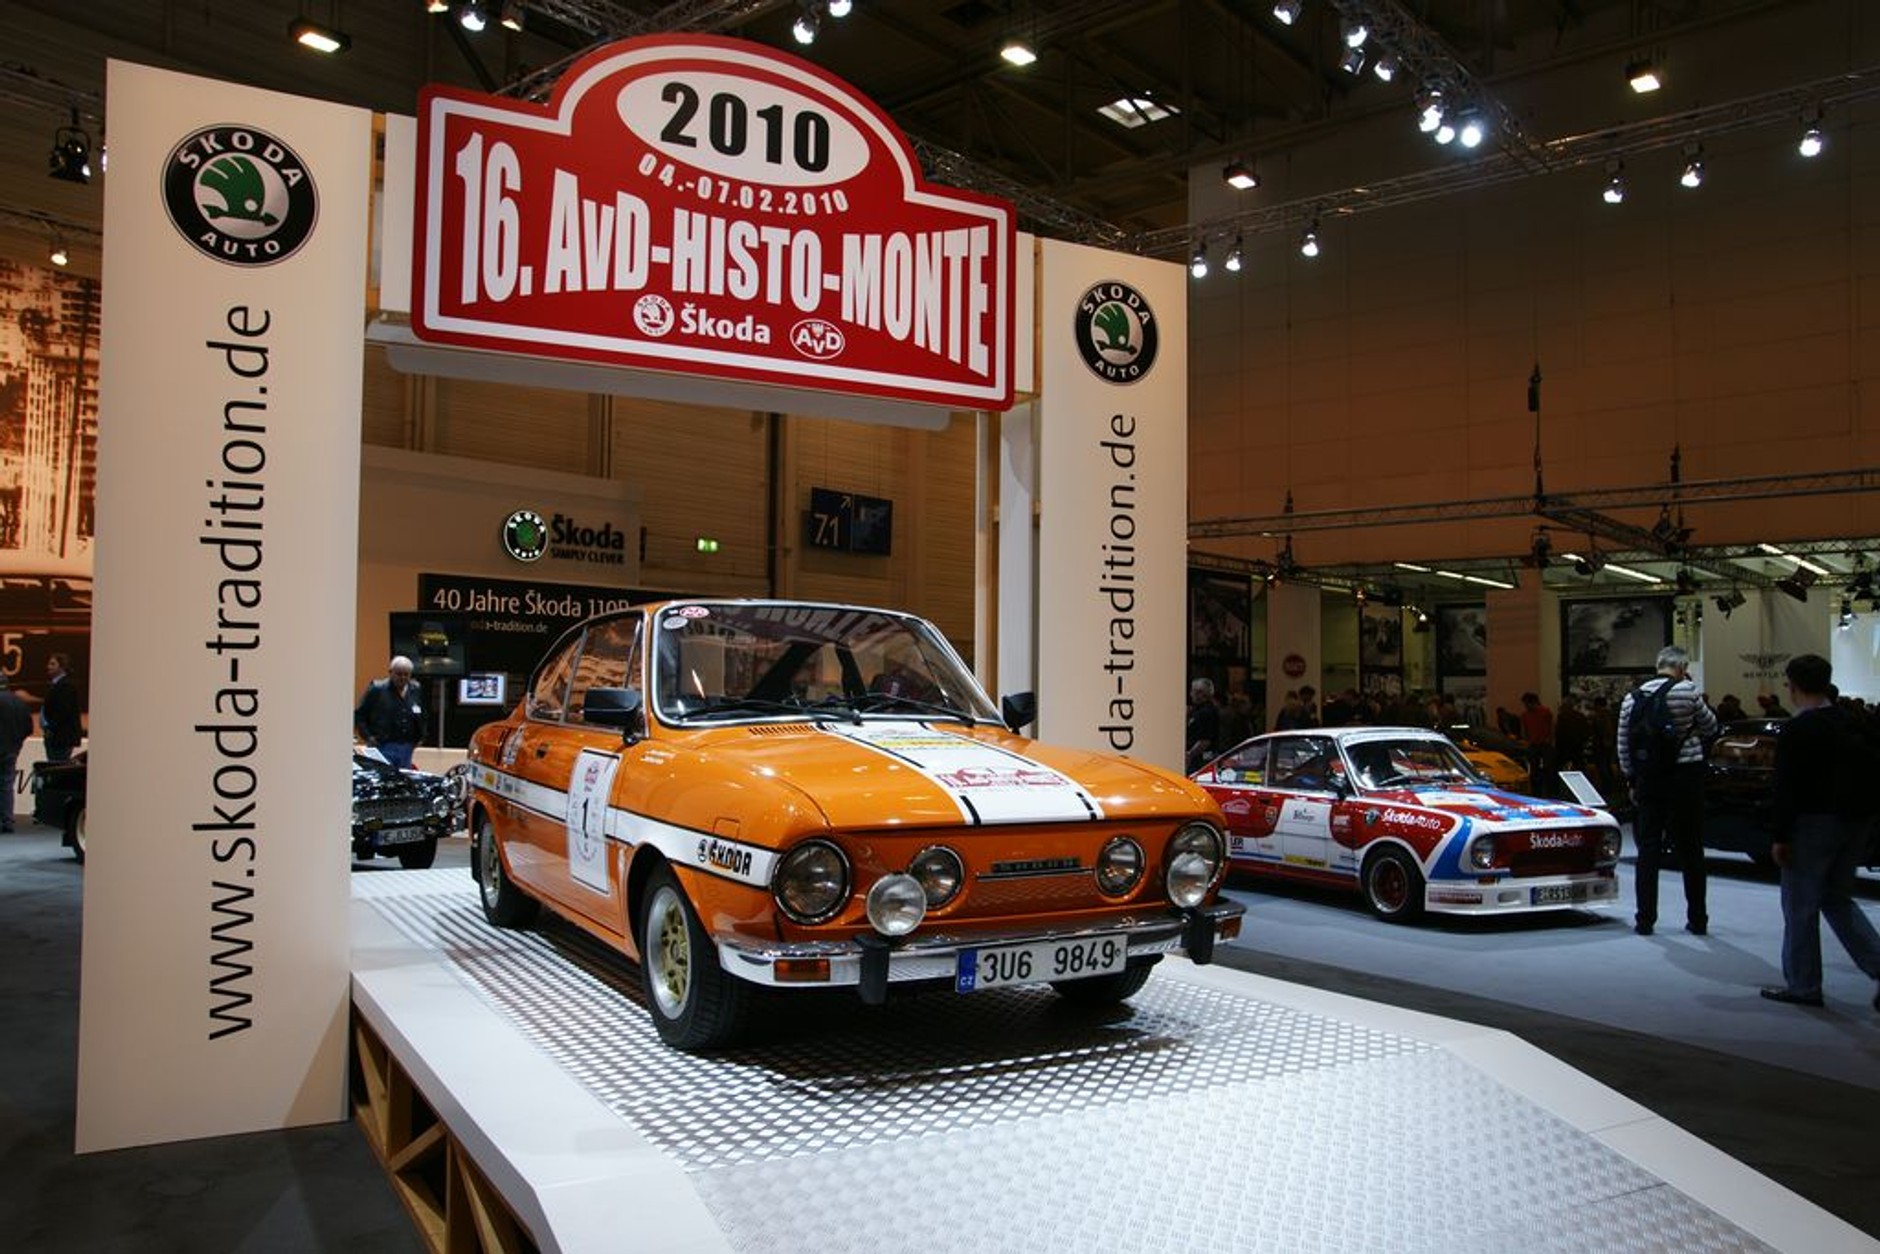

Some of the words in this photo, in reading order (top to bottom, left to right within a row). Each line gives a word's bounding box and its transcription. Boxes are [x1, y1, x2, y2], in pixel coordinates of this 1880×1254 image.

[661, 82, 829, 173] 2010
[201, 232, 280, 257] AUTO
[456, 132, 532, 304] 16.
[544, 168, 989, 377] AvD-HISTO-MONTE
[680, 302, 771, 344] Škoda
[1095, 359, 1140, 379] AUTO
[551, 514, 625, 549] Škoda
[433, 588, 460, 611] 40
[465, 588, 519, 614] Jahre
[525, 589, 582, 618] Škoda
[1098, 414, 1136, 752] da-tradition.de
[192, 304, 271, 1040] www.skoda-tradition.de
[960, 976, 974, 986] CZ
[983, 951, 1033, 983] 3U6
[1054, 940, 1115, 974] 9849
